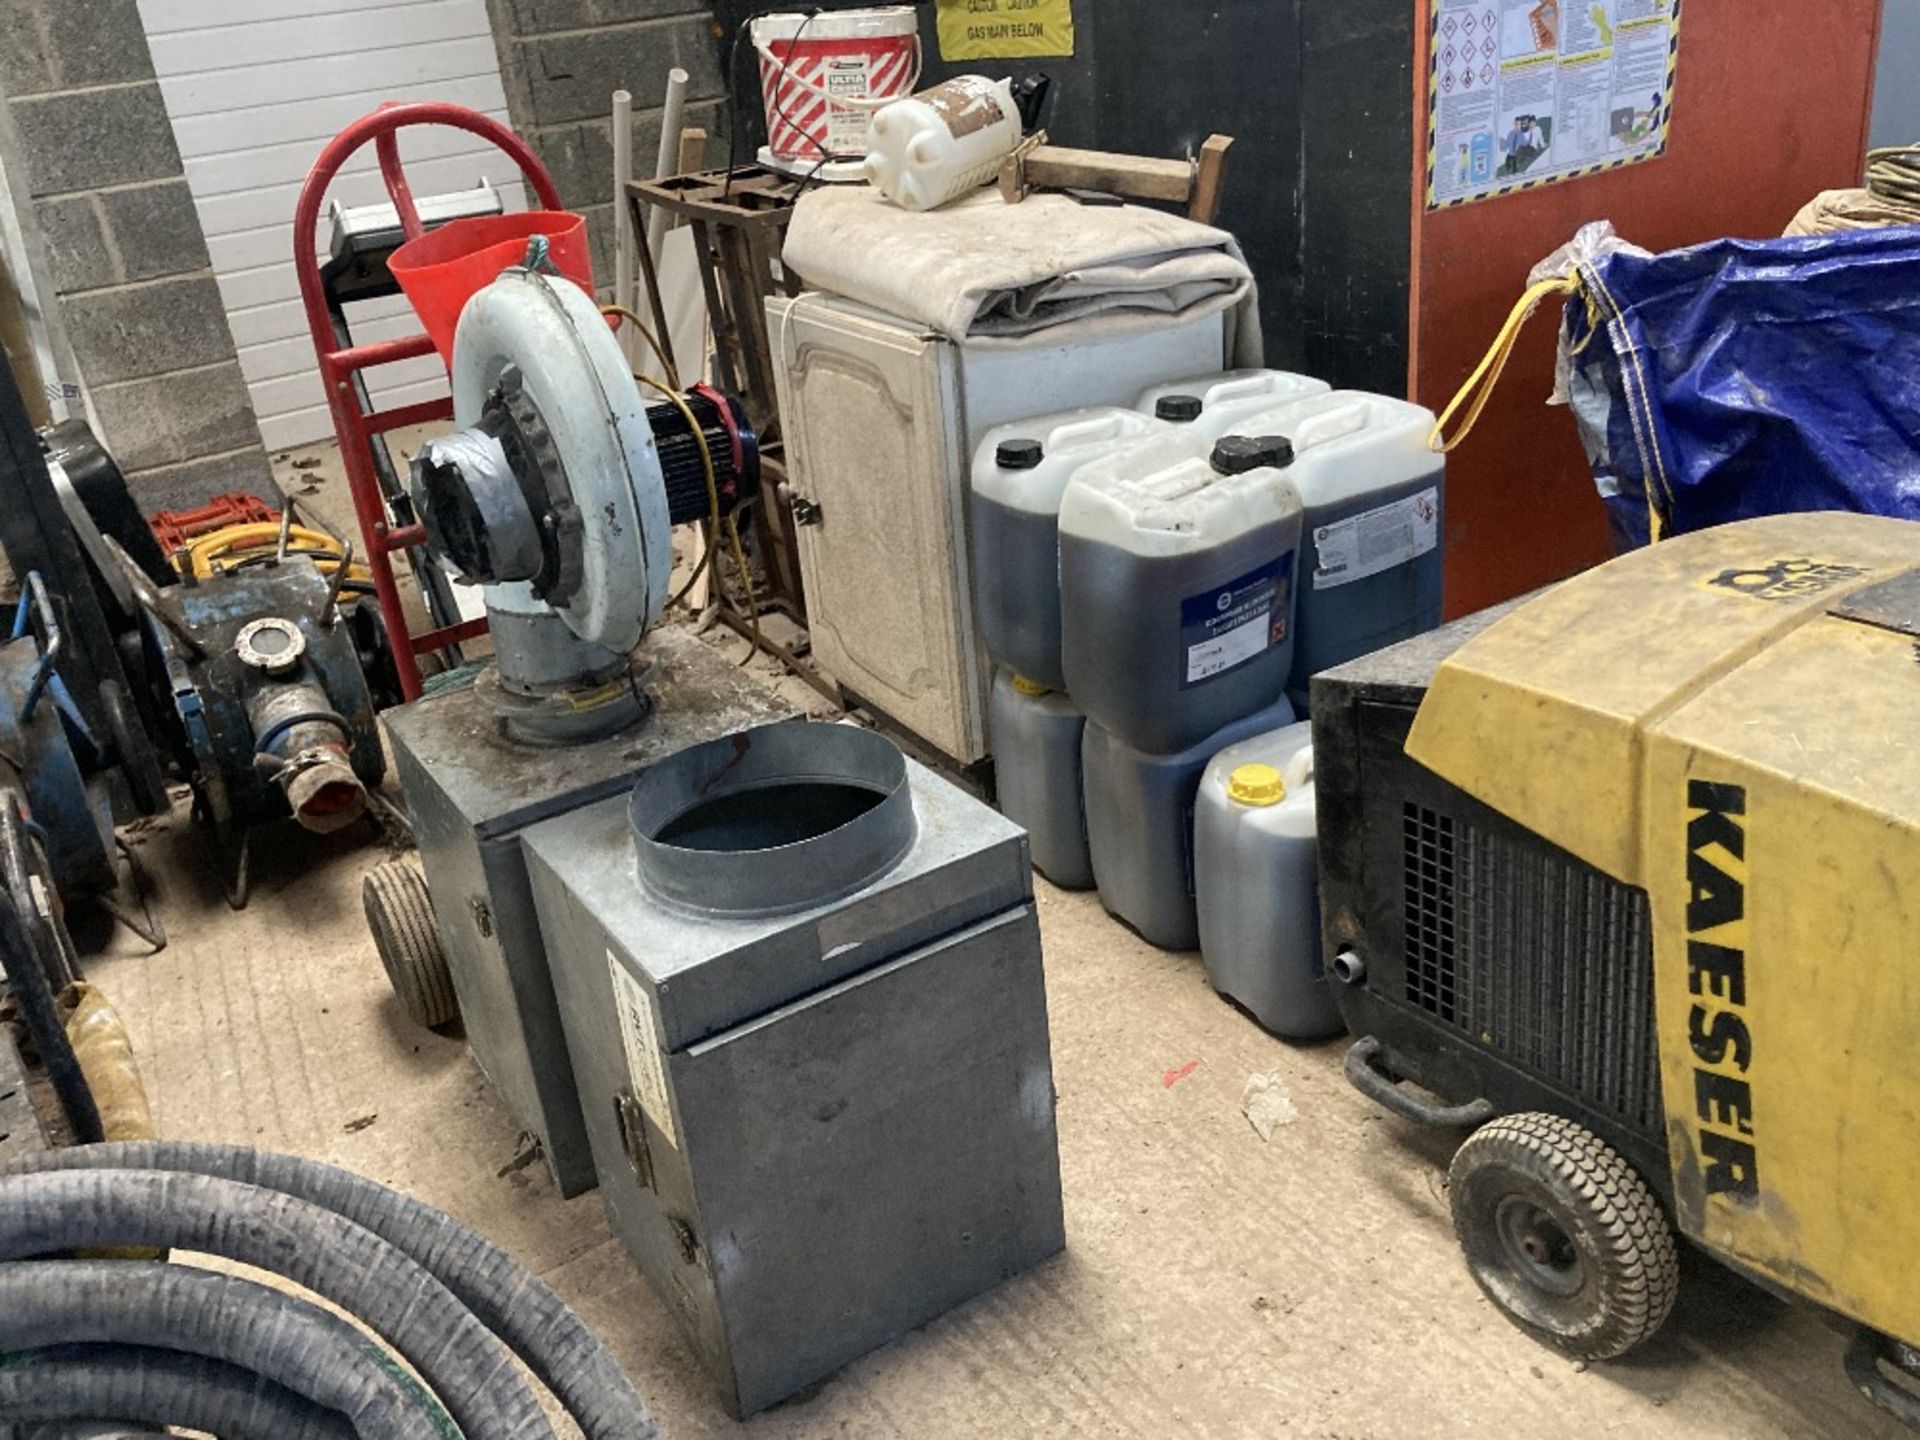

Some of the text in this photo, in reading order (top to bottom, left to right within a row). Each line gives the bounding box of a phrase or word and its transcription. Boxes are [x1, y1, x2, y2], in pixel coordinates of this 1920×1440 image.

[967, 22, 1044, 40] GAS MAIN BELOW
[1686, 778, 1760, 1206] KAESER
